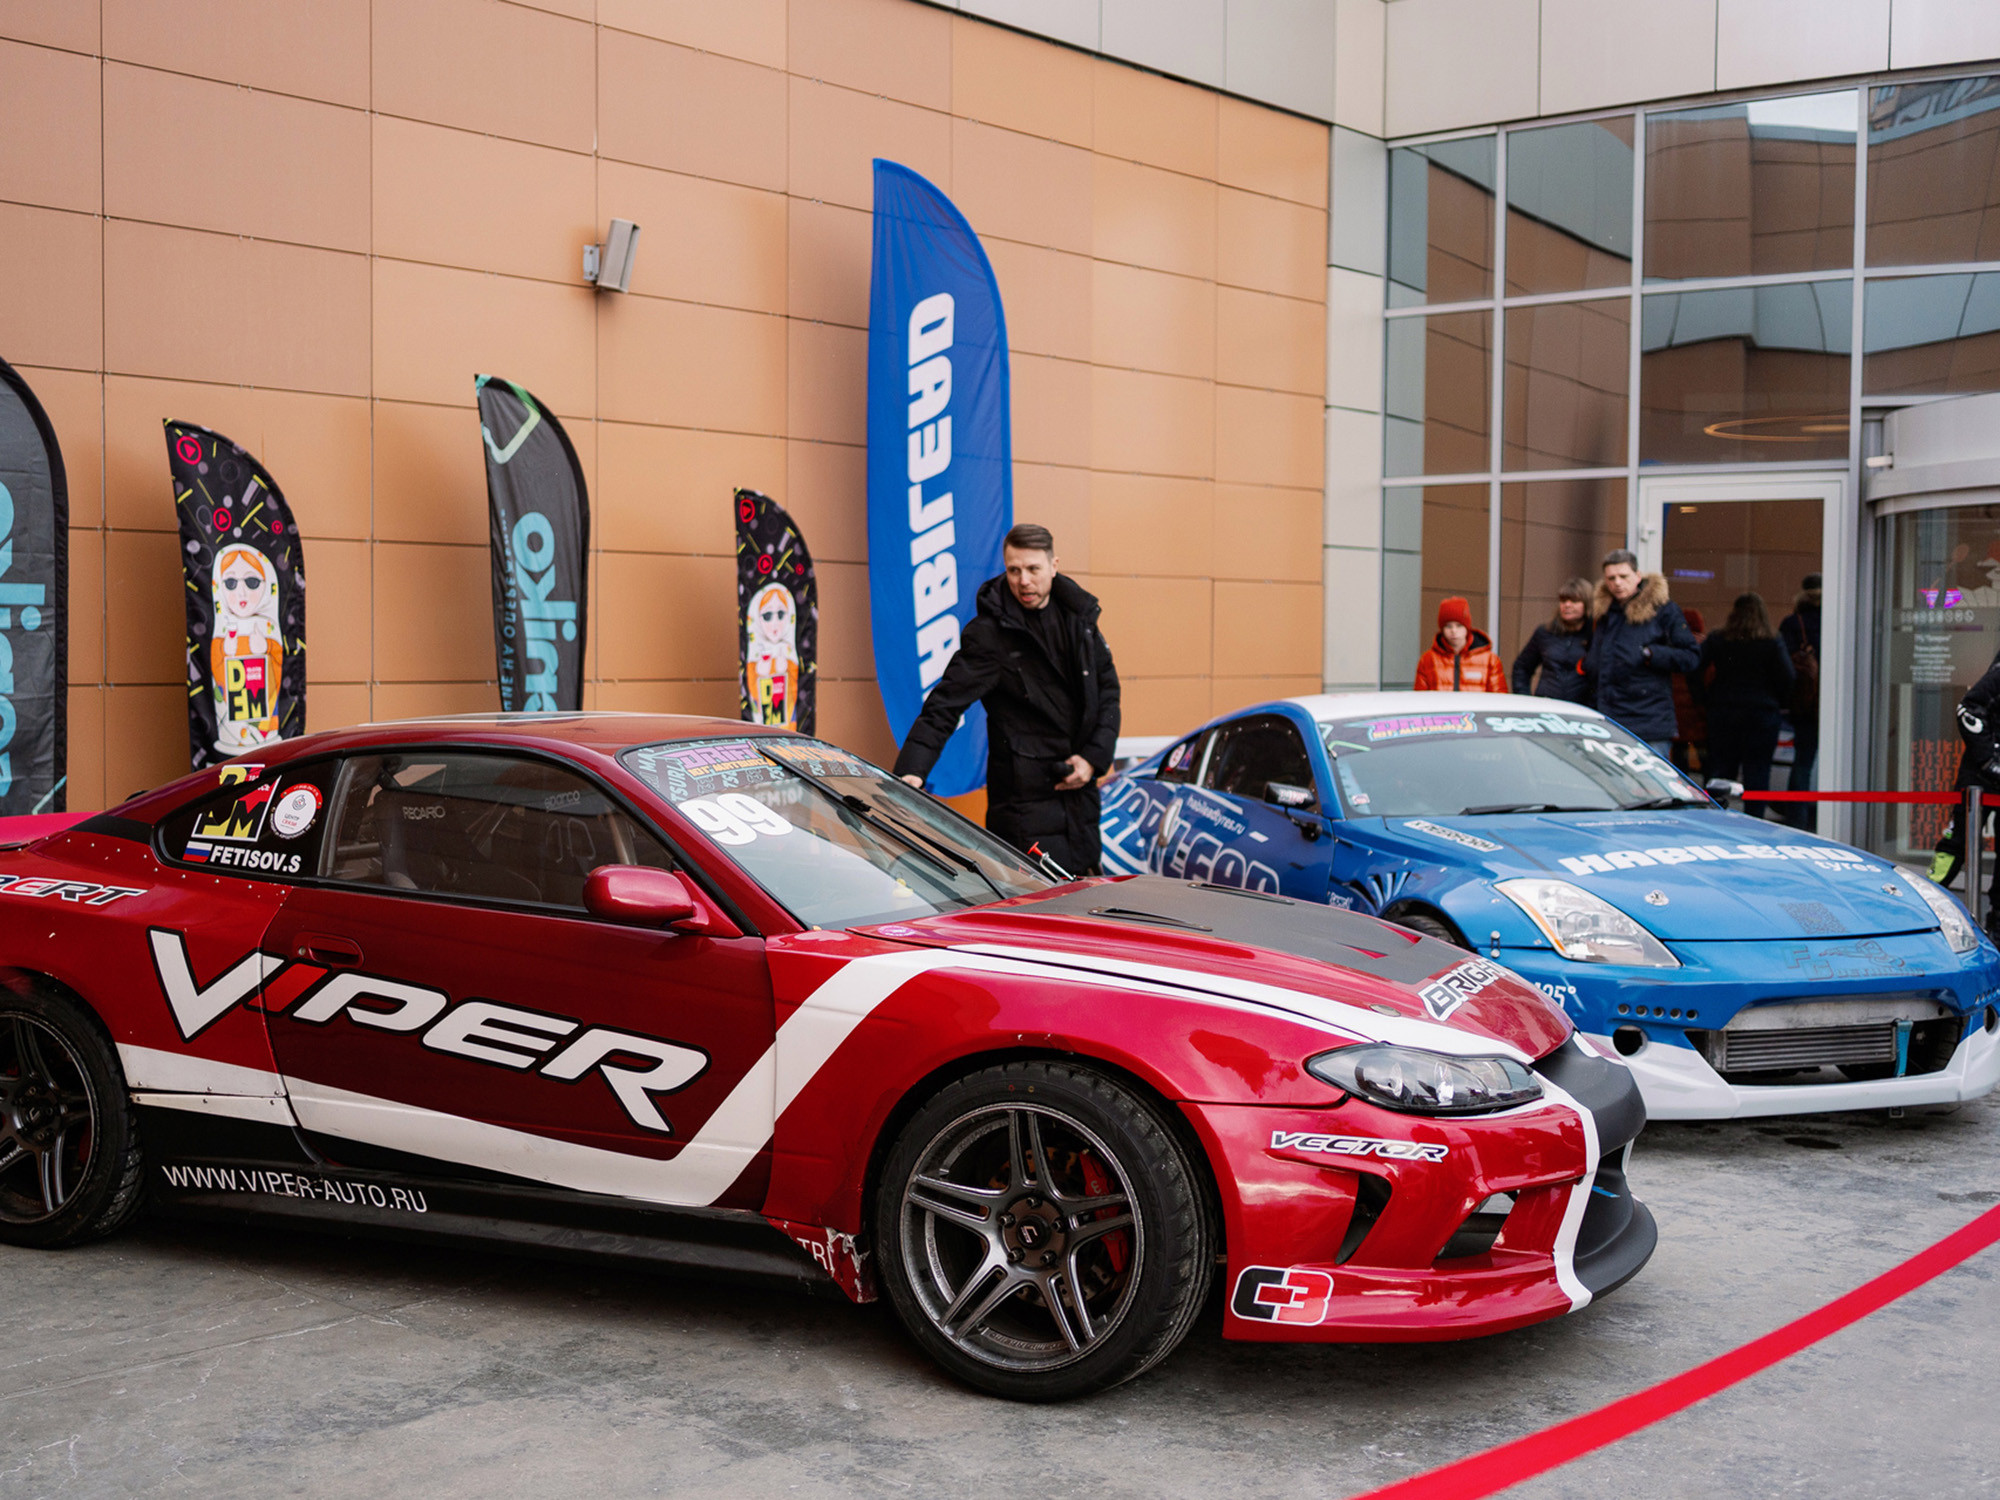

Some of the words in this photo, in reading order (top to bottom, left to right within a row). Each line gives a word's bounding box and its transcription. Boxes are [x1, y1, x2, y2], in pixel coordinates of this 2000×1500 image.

[1485, 713, 1612, 739] seniko
[402, 805, 446, 820] RECARO
[678, 792, 794, 845] 99
[1187, 796, 1246, 835] habileadtyres.ru
[210, 845, 302, 874] FETISOV.S
[1557, 844, 1865, 876] HABILEAD
[1814, 860, 1882, 873] tyres
[148, 926, 709, 1134] VIPER
[1271, 1131, 1449, 1163] VECTOR
[162, 1165, 428, 1213] WWW.VIPER-AUTO.RU
